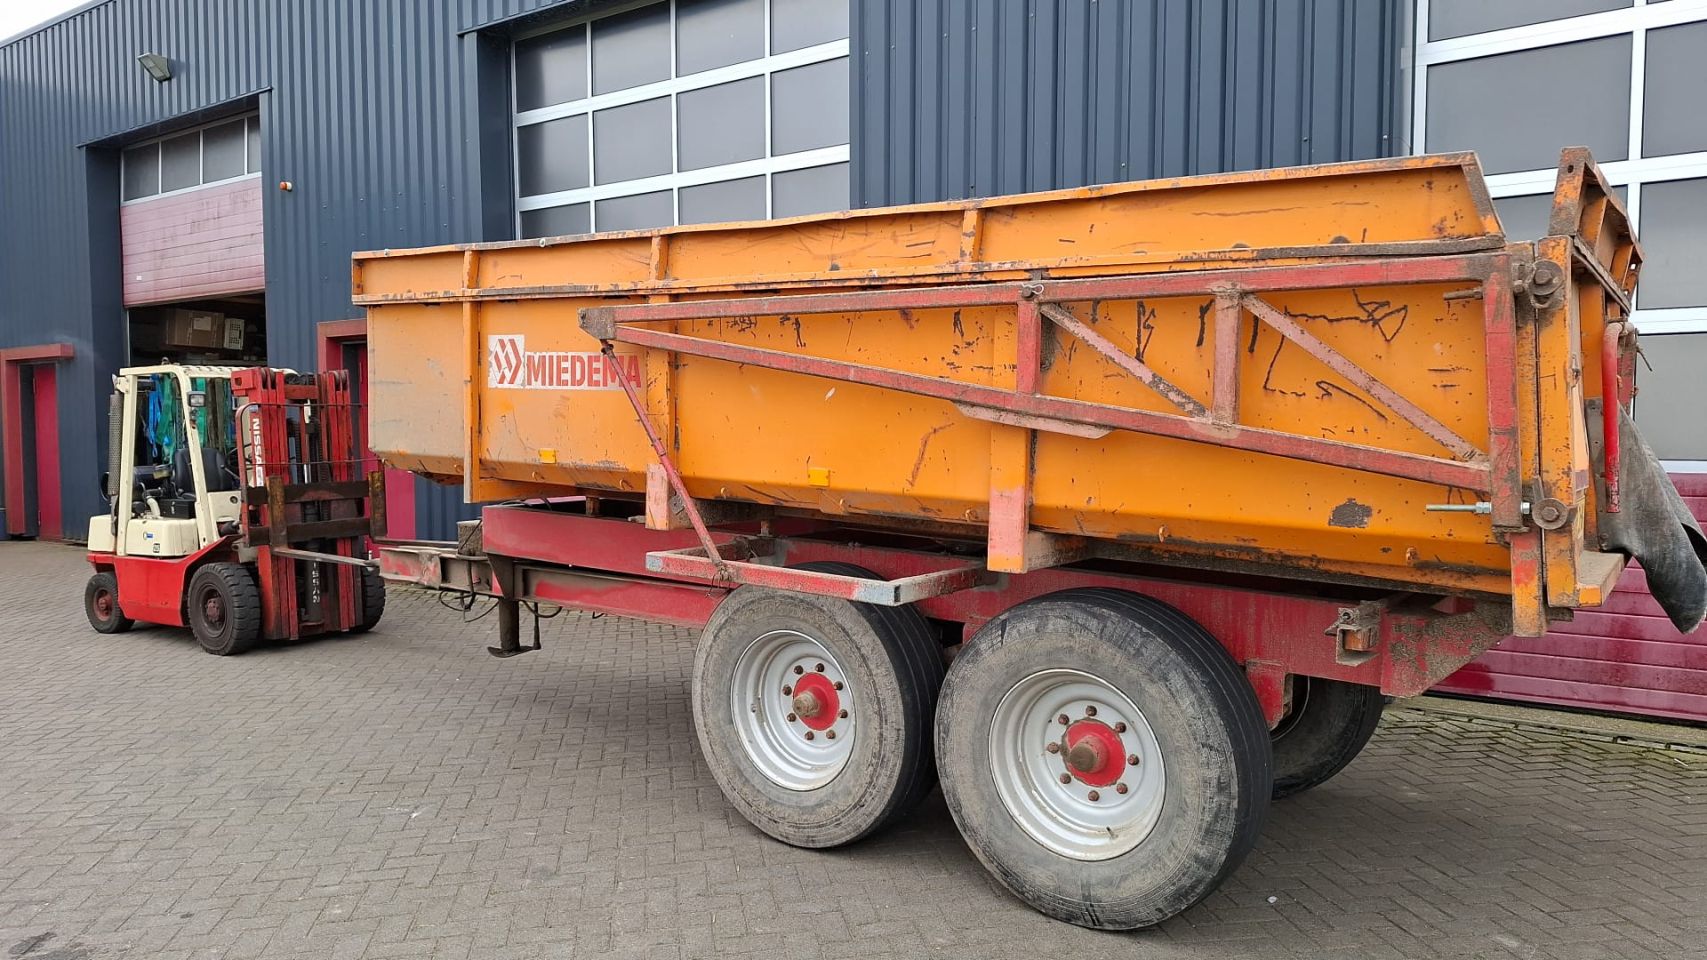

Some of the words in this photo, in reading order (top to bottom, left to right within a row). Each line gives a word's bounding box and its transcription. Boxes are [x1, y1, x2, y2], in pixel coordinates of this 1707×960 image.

[526, 355, 641, 388] MIEDEMA
[252, 418, 263, 468] NISSA
[312, 560, 321, 603] ISSAN
